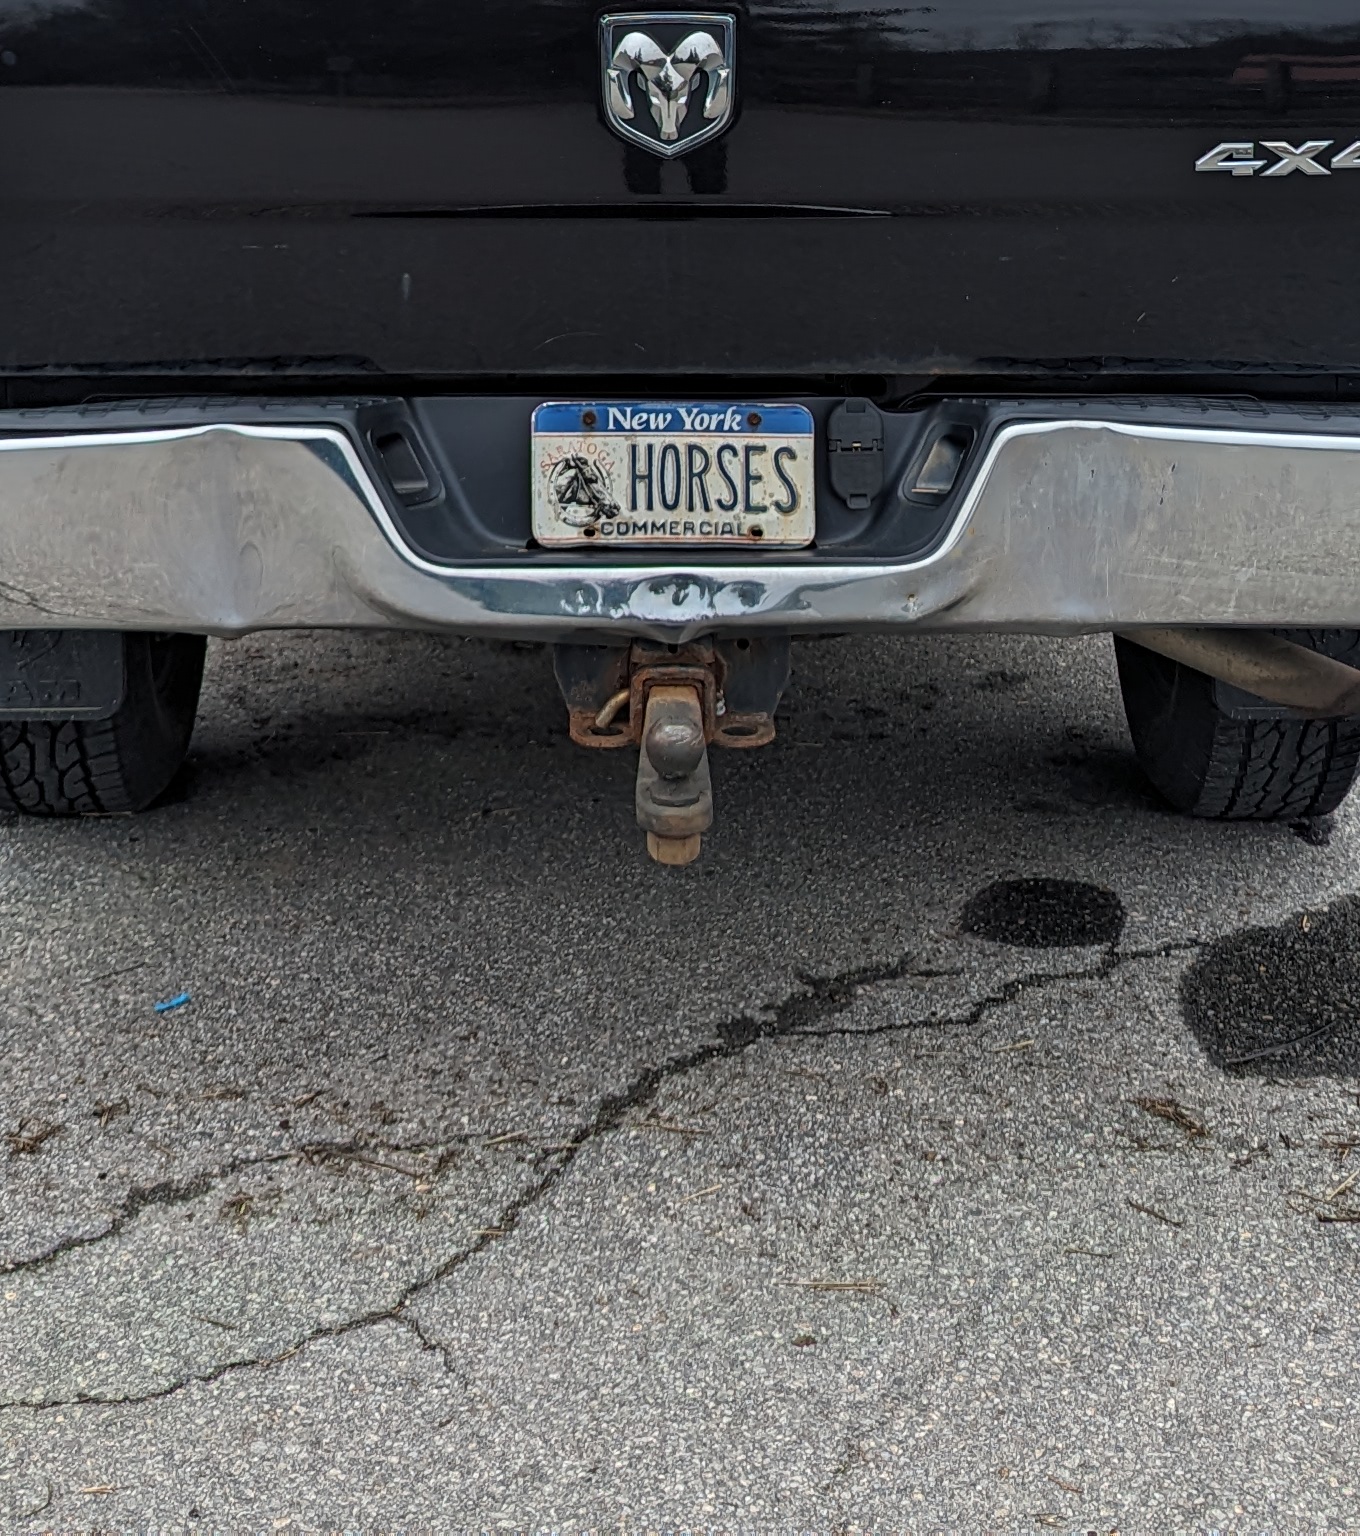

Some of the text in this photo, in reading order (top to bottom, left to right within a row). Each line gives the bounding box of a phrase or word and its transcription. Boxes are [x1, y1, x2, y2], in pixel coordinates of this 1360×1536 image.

[607, 406, 742, 431] New York
[540, 440, 615, 473] SARATOGA
[630, 443, 798, 514] HORSES
[600, 520, 747, 536] COMMERCIAL
